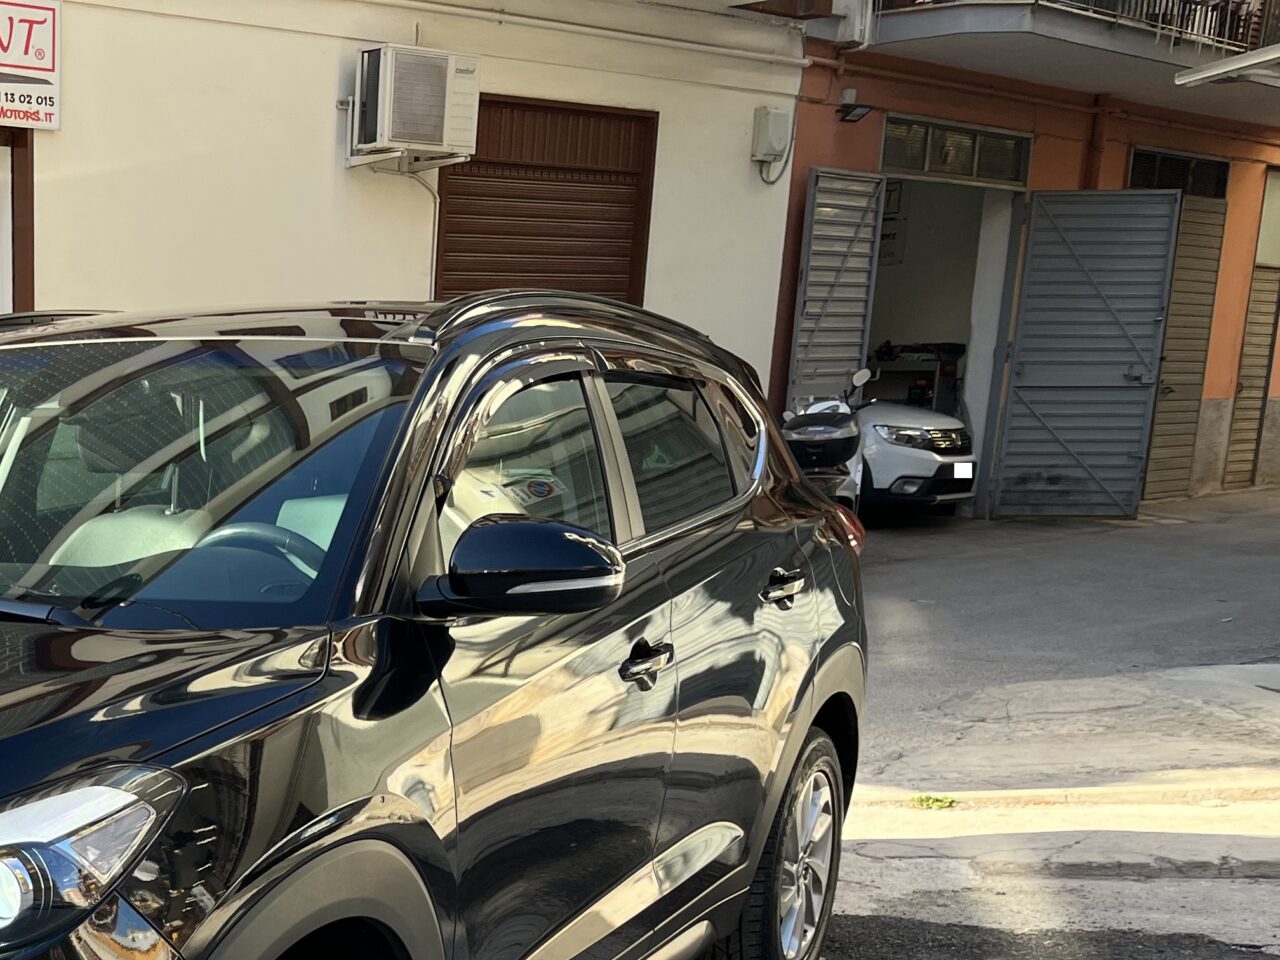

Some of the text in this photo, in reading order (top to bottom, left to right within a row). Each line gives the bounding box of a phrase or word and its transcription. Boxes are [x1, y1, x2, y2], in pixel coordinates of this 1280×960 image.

[4, 92, 16, 103] 13
[19, 94, 33, 105] 02
[35, 96, 55, 107] 015
